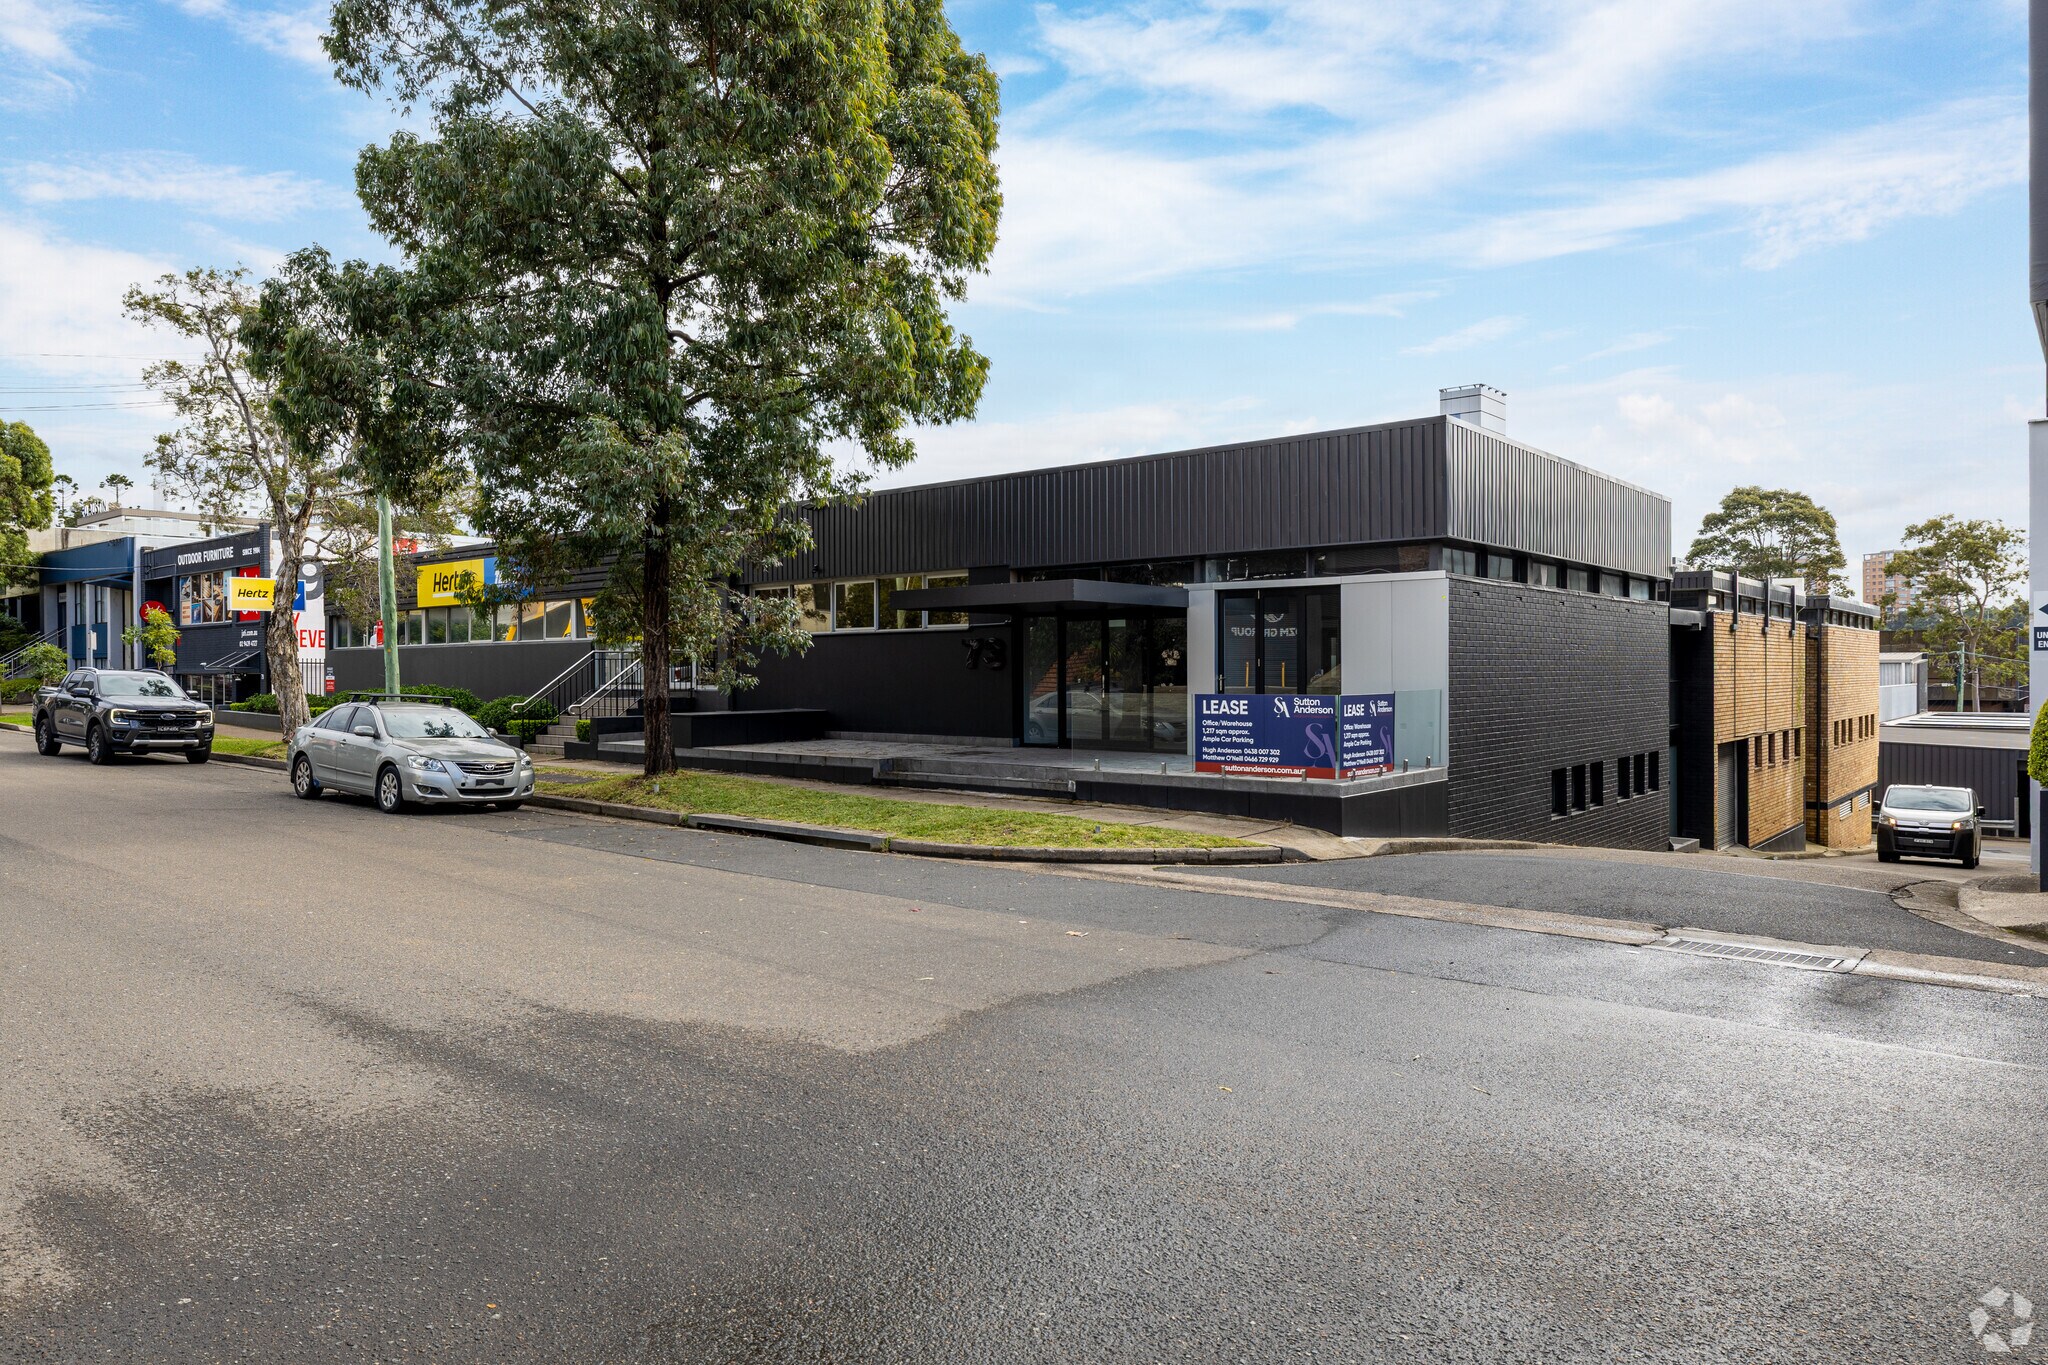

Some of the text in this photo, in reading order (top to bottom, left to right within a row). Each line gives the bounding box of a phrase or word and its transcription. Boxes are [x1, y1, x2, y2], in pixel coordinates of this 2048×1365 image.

[178, 546, 234, 566] OUTDOOR FURNITURE
[242, 548, 252, 556] SINCE
[238, 588, 269, 599] Hertz
[1294, 698, 1320, 706] Sutton
[1203, 700, 1248, 715] LEASE
[1294, 706, 1333, 714] Anderson
[1344, 704, 1364, 717] LEASE
[1225, 765, 1302, 774] suttonanderson.com.au
